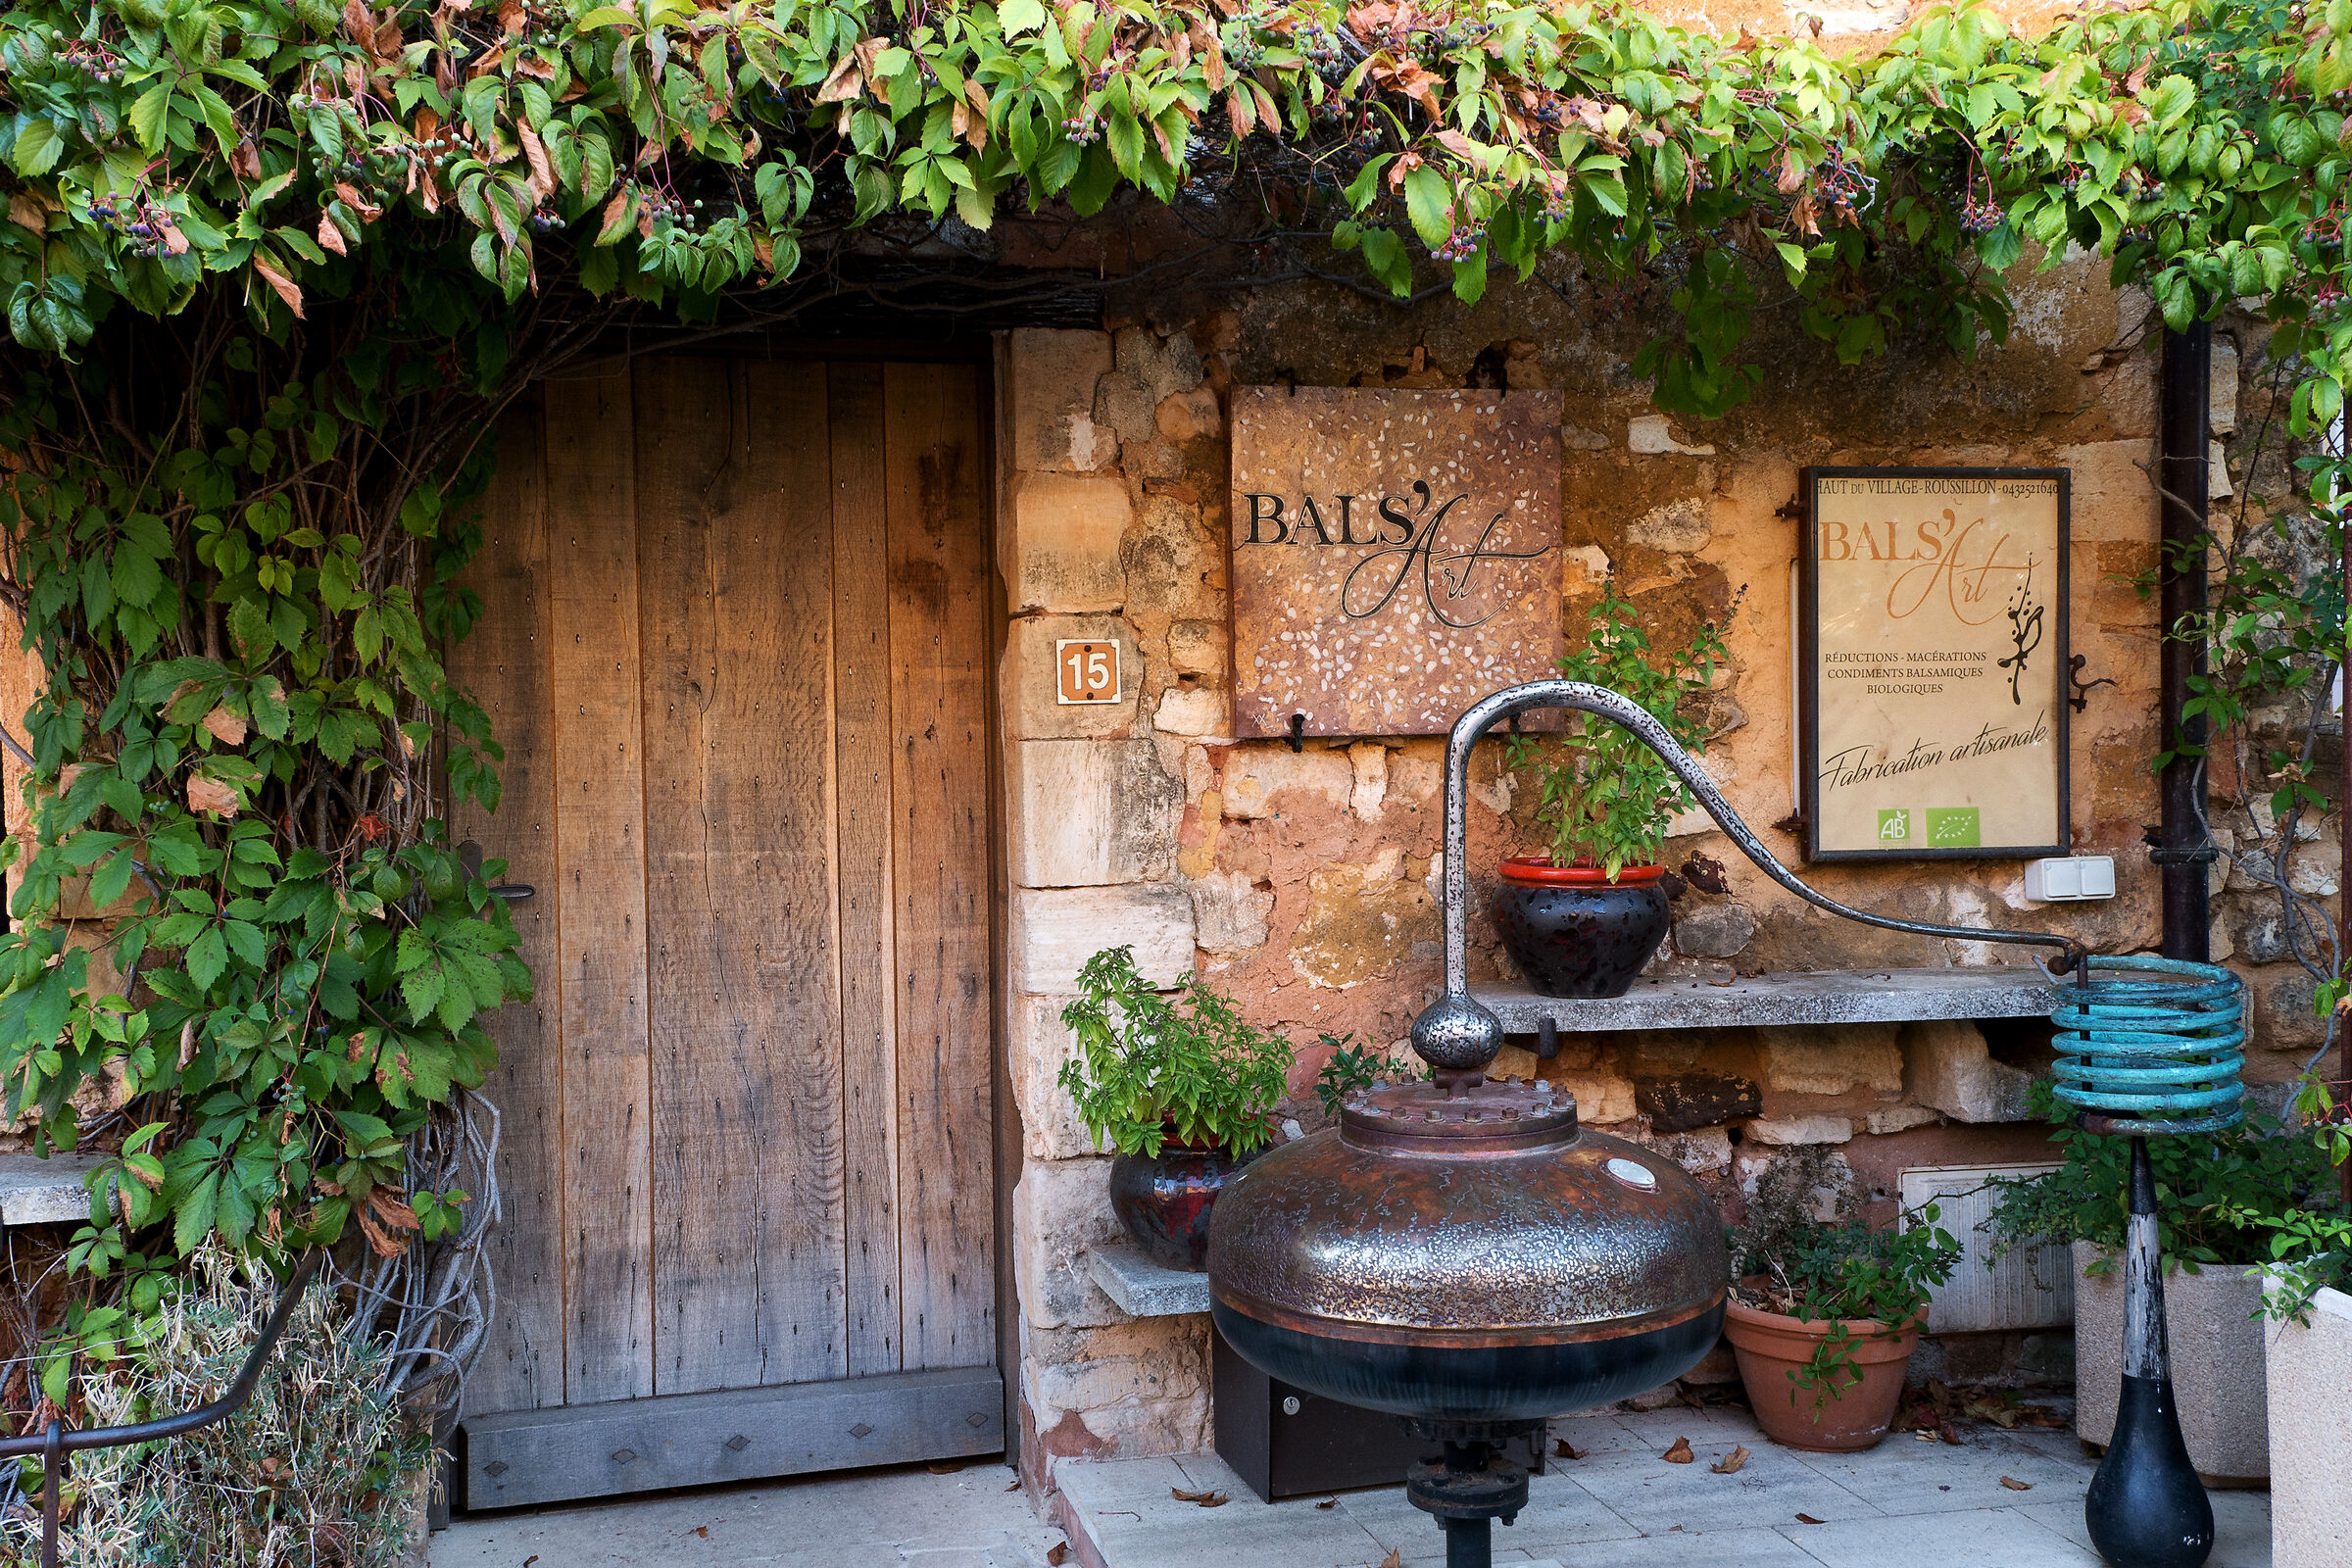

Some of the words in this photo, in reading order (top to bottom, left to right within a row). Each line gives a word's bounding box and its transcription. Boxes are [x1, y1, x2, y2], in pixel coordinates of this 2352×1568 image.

[1851, 483, 1864, 495] DU
[1825, 652, 1898, 663] RÉDUCTIONS
[1906, 651, 1986, 662] MACÉRATIONS
[1067, 652, 1109, 691] 15
[1827, 668, 1904, 679] CONDIMENTS
[1906, 667, 1984, 679] BALSAMIQUES
[1867, 683, 1943, 695] BIOLOGIQUES
[1819, 737, 1945, 791] Fabrication
[1949, 710, 2049, 760] artisanale
[1880, 817, 1906, 839] AB
